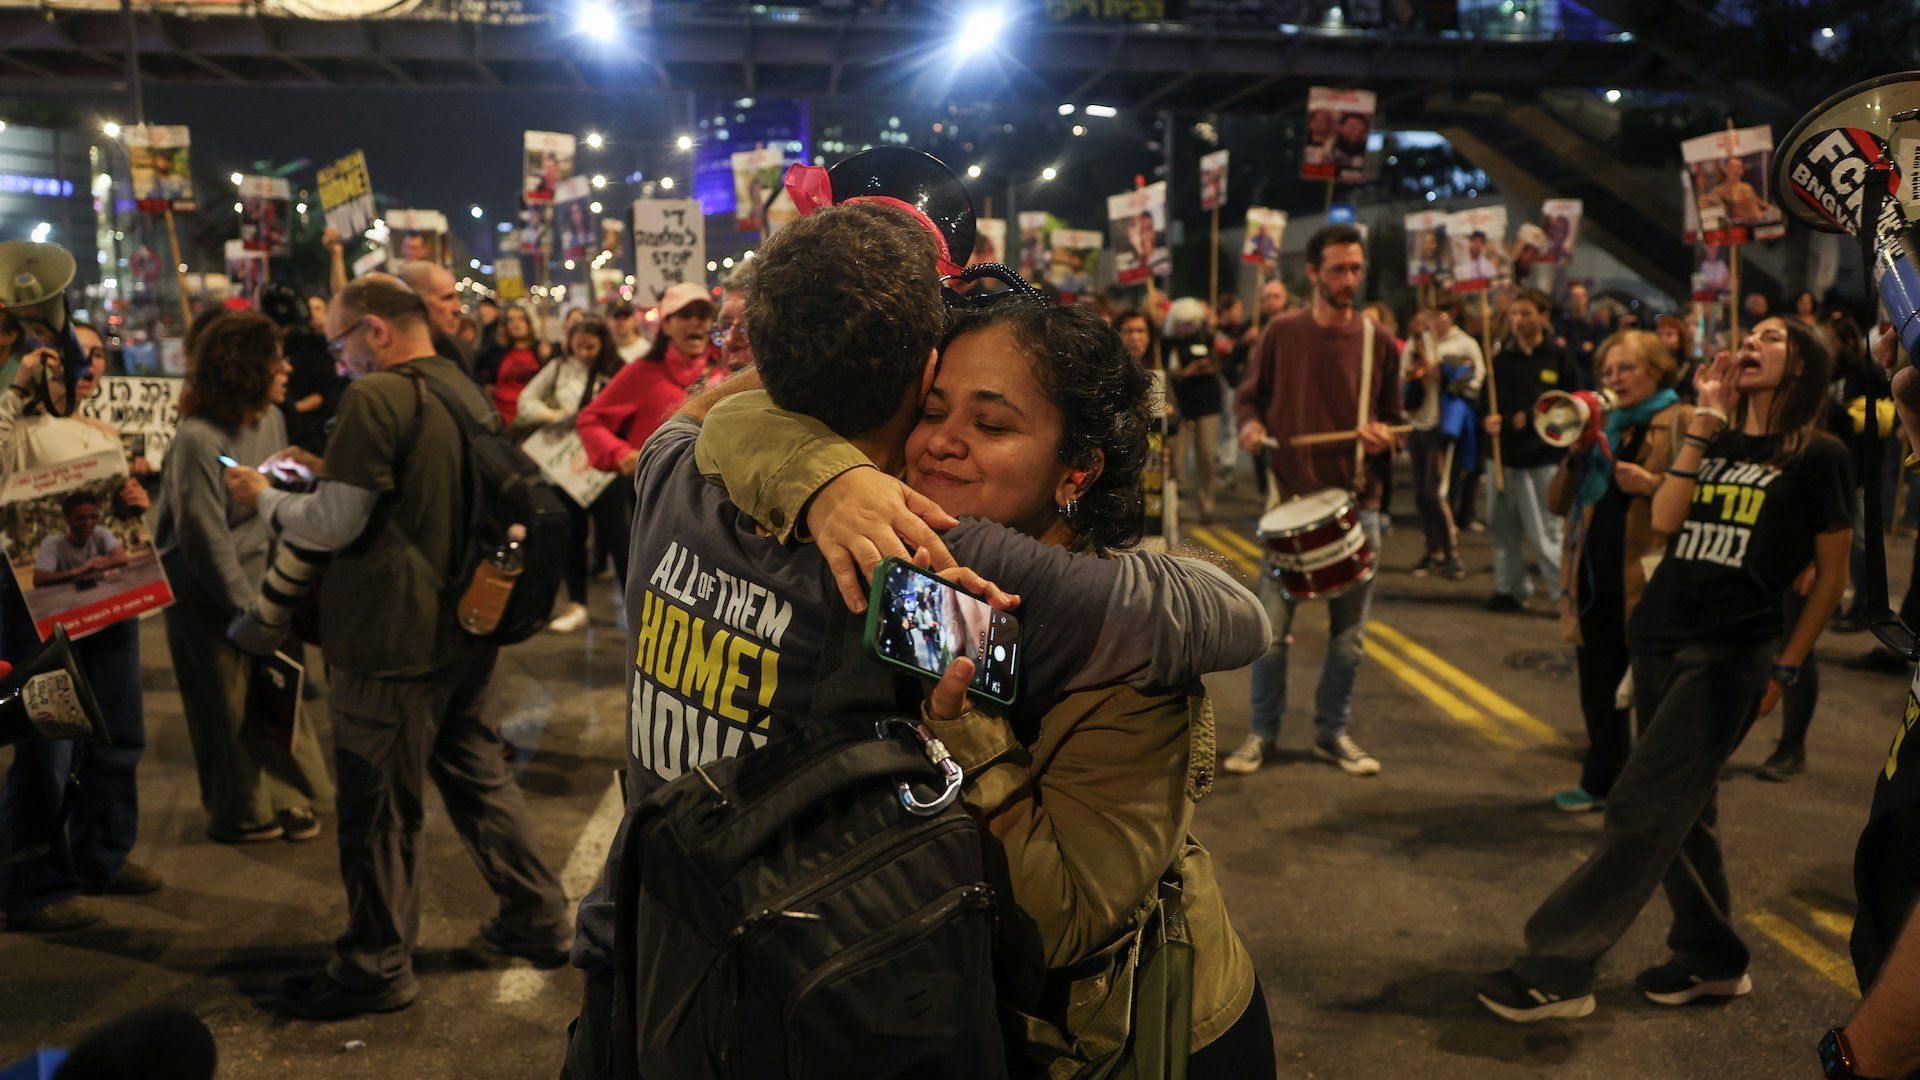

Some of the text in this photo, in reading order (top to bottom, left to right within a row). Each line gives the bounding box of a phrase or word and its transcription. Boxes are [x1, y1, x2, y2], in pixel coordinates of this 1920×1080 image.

[651, 250, 692, 267] STOP
[649, 541, 793, 648] ALL OF THEM
[1674, 520, 1751, 568] בעזה
[635, 590, 780, 730] HOME!
[632, 670, 769, 782] NOW
